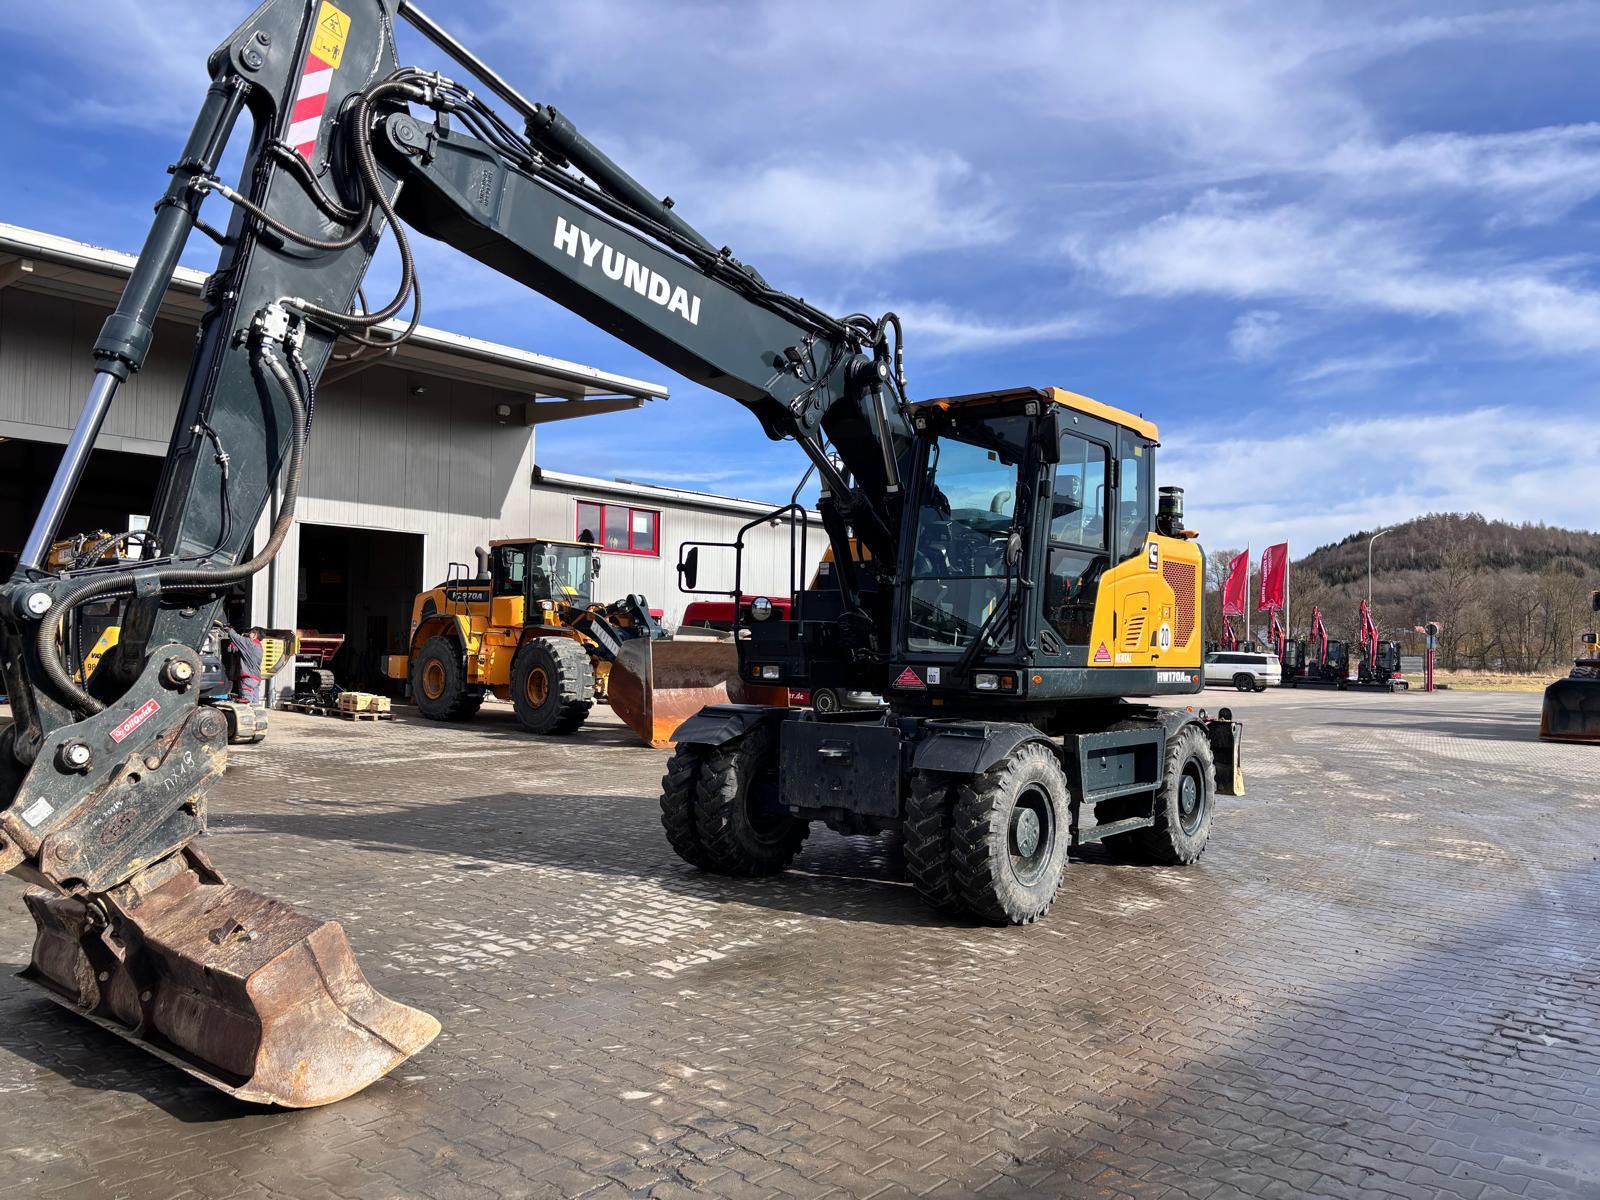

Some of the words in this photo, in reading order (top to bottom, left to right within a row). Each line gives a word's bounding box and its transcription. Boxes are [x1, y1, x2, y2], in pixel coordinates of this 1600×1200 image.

[554, 216, 701, 326] HYUNDAI
[591, 620, 620, 657] HYUND
[1161, 628, 1169, 646] 20
[124, 705, 153, 732] OilQuick
